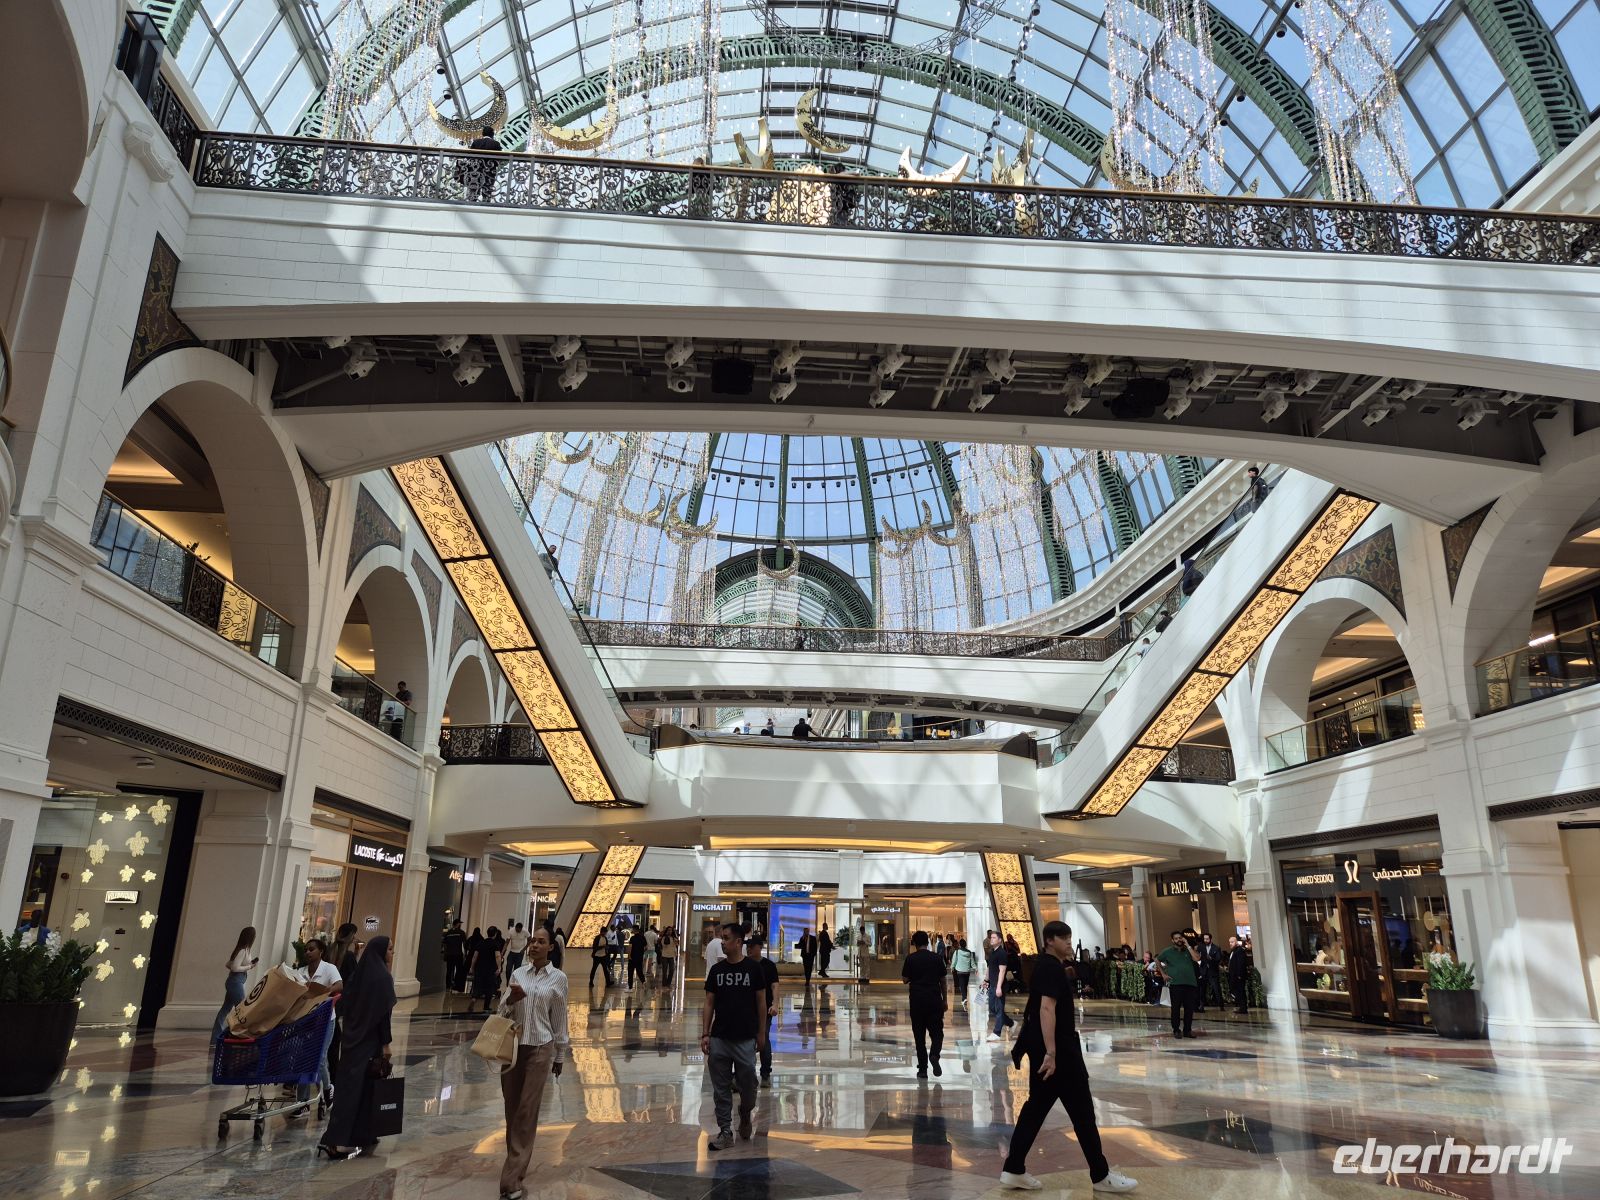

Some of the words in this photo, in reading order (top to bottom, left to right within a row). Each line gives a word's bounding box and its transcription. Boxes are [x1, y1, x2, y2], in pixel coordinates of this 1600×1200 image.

[354, 844, 377, 860] LACOSTE
[385, 853, 404, 867] لاكوست
[1372, 868, 1404, 882] صديقي
[1403, 864, 1421, 877] أحمد
[1201, 879, 1222, 892] بول
[1296, 875, 1314, 885] AHMED
[1170, 881, 1190, 894] PAUL
[692, 903, 732, 911] BINGHATTI
[716, 972, 751, 987] USPA
